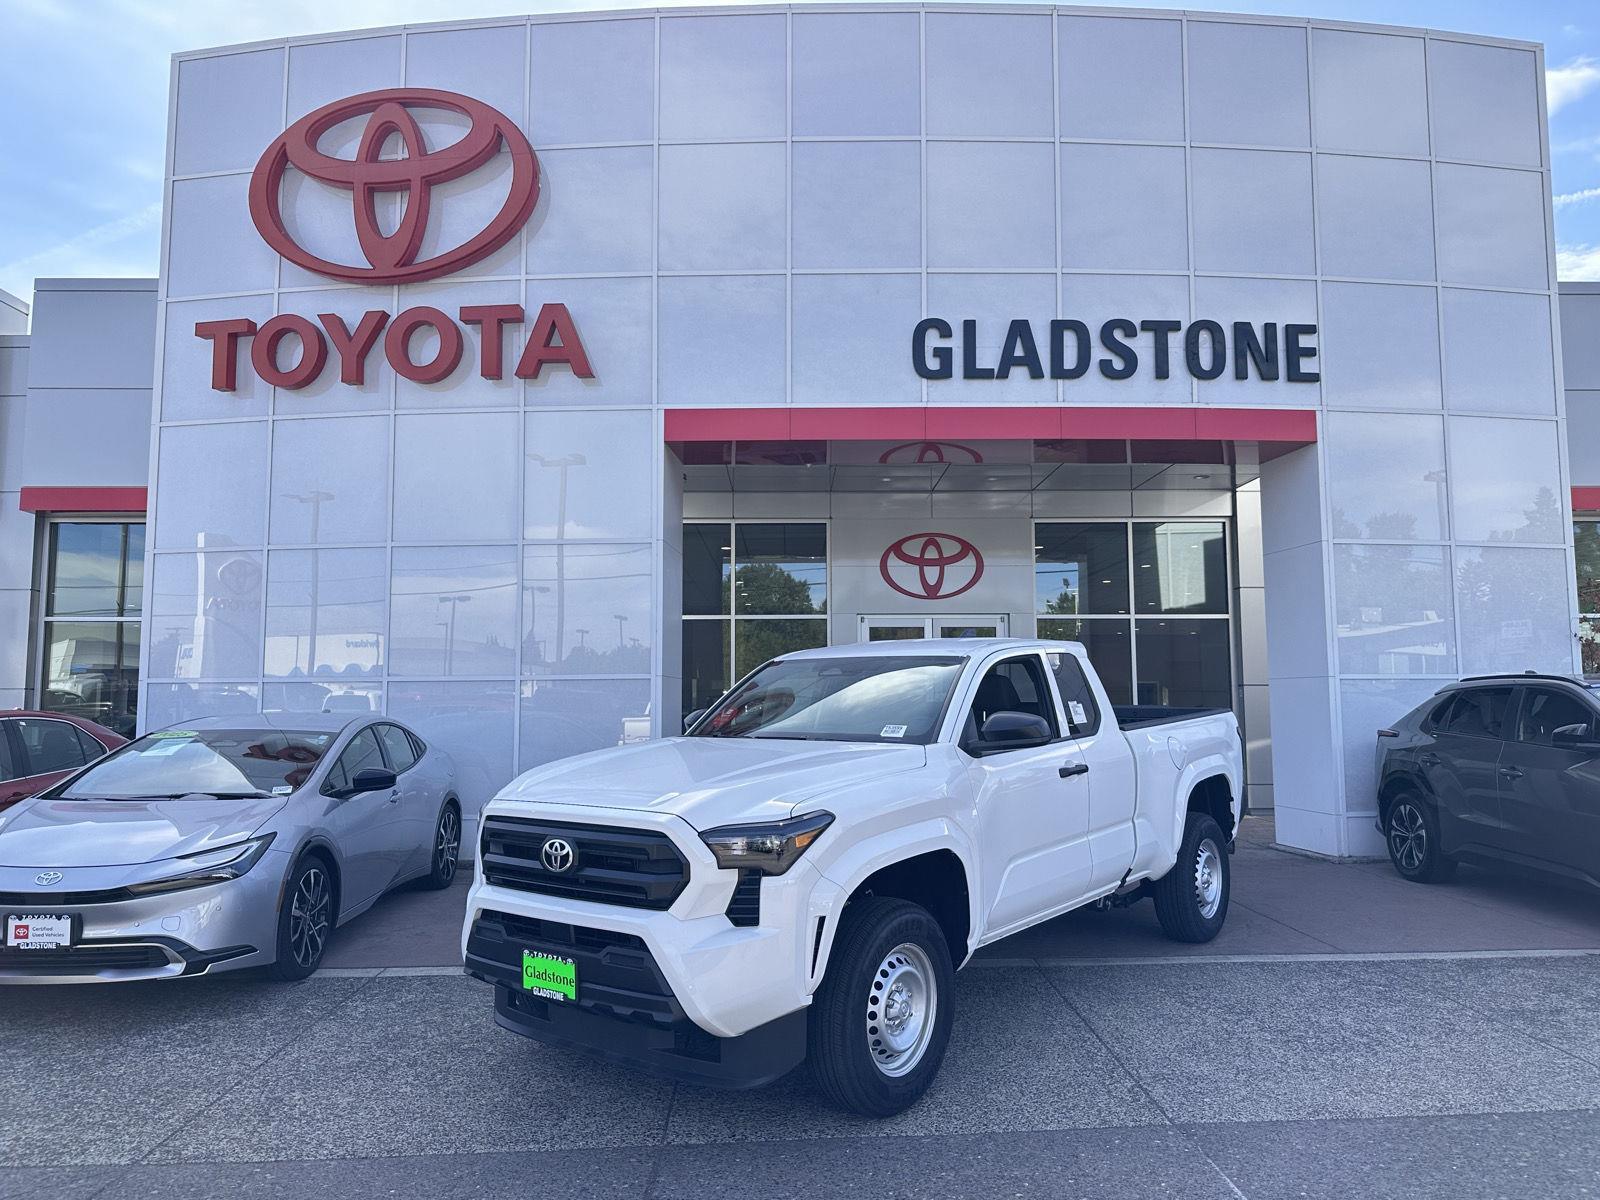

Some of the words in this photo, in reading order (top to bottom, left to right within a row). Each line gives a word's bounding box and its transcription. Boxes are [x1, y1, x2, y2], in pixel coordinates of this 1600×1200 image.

[195, 303, 596, 392] TOYOTA
[912, 318, 1320, 383] GLADSTONE
[534, 951, 562, 961] TOYOTA
[525, 965, 574, 987] Gladstone
[533, 987, 564, 1001] GLADSTONE
